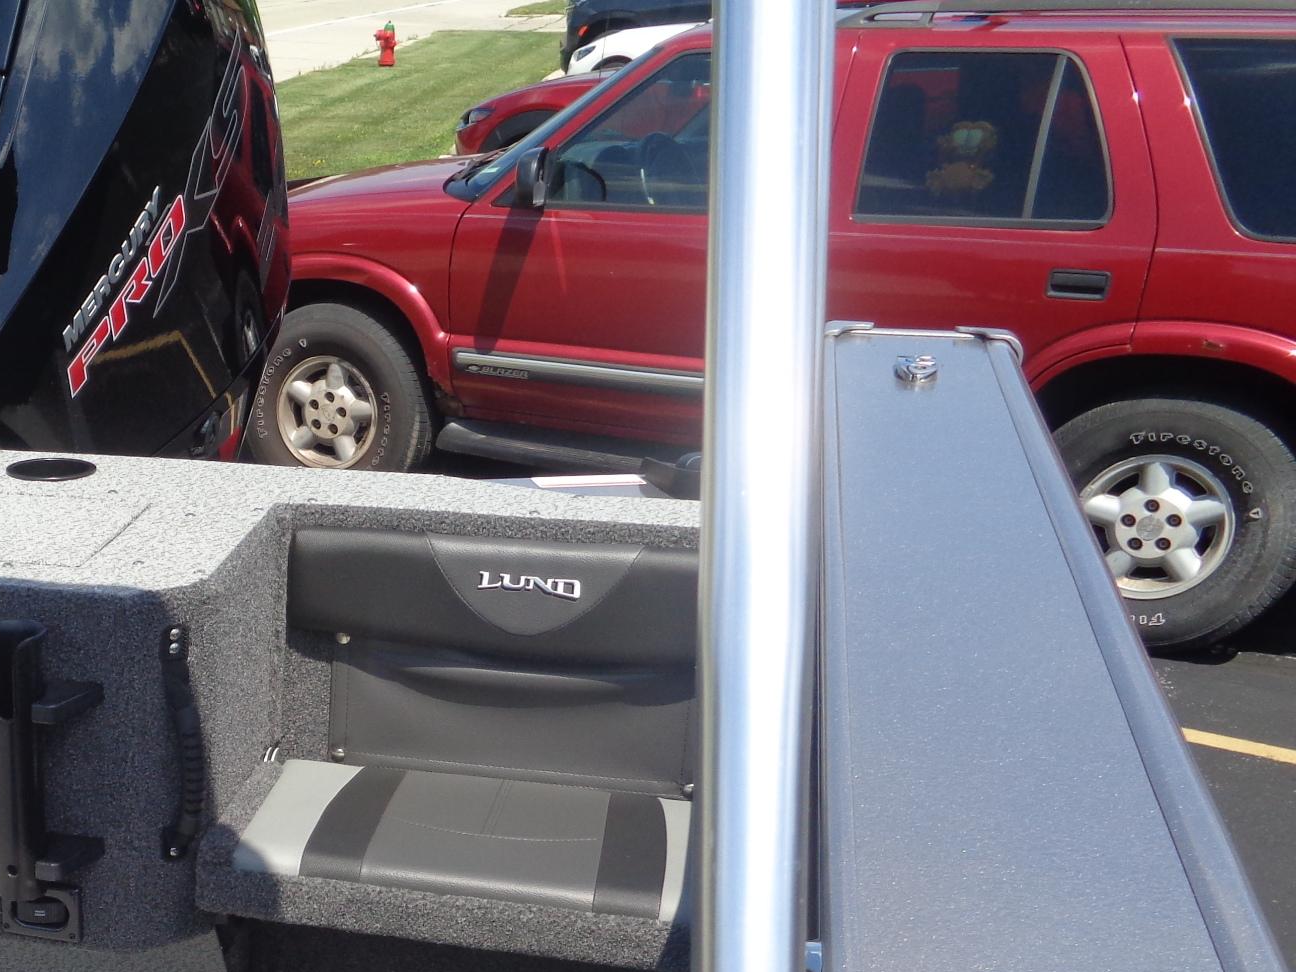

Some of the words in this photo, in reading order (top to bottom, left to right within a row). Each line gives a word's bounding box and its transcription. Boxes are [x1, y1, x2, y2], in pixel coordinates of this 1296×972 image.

[62, 185, 159, 353] MERCURY
[67, 194, 185, 399] PRO
[256, 347, 292, 439] Firestone
[1129, 430, 1254, 494] Firestone
[477, 570, 582, 601] LUND
